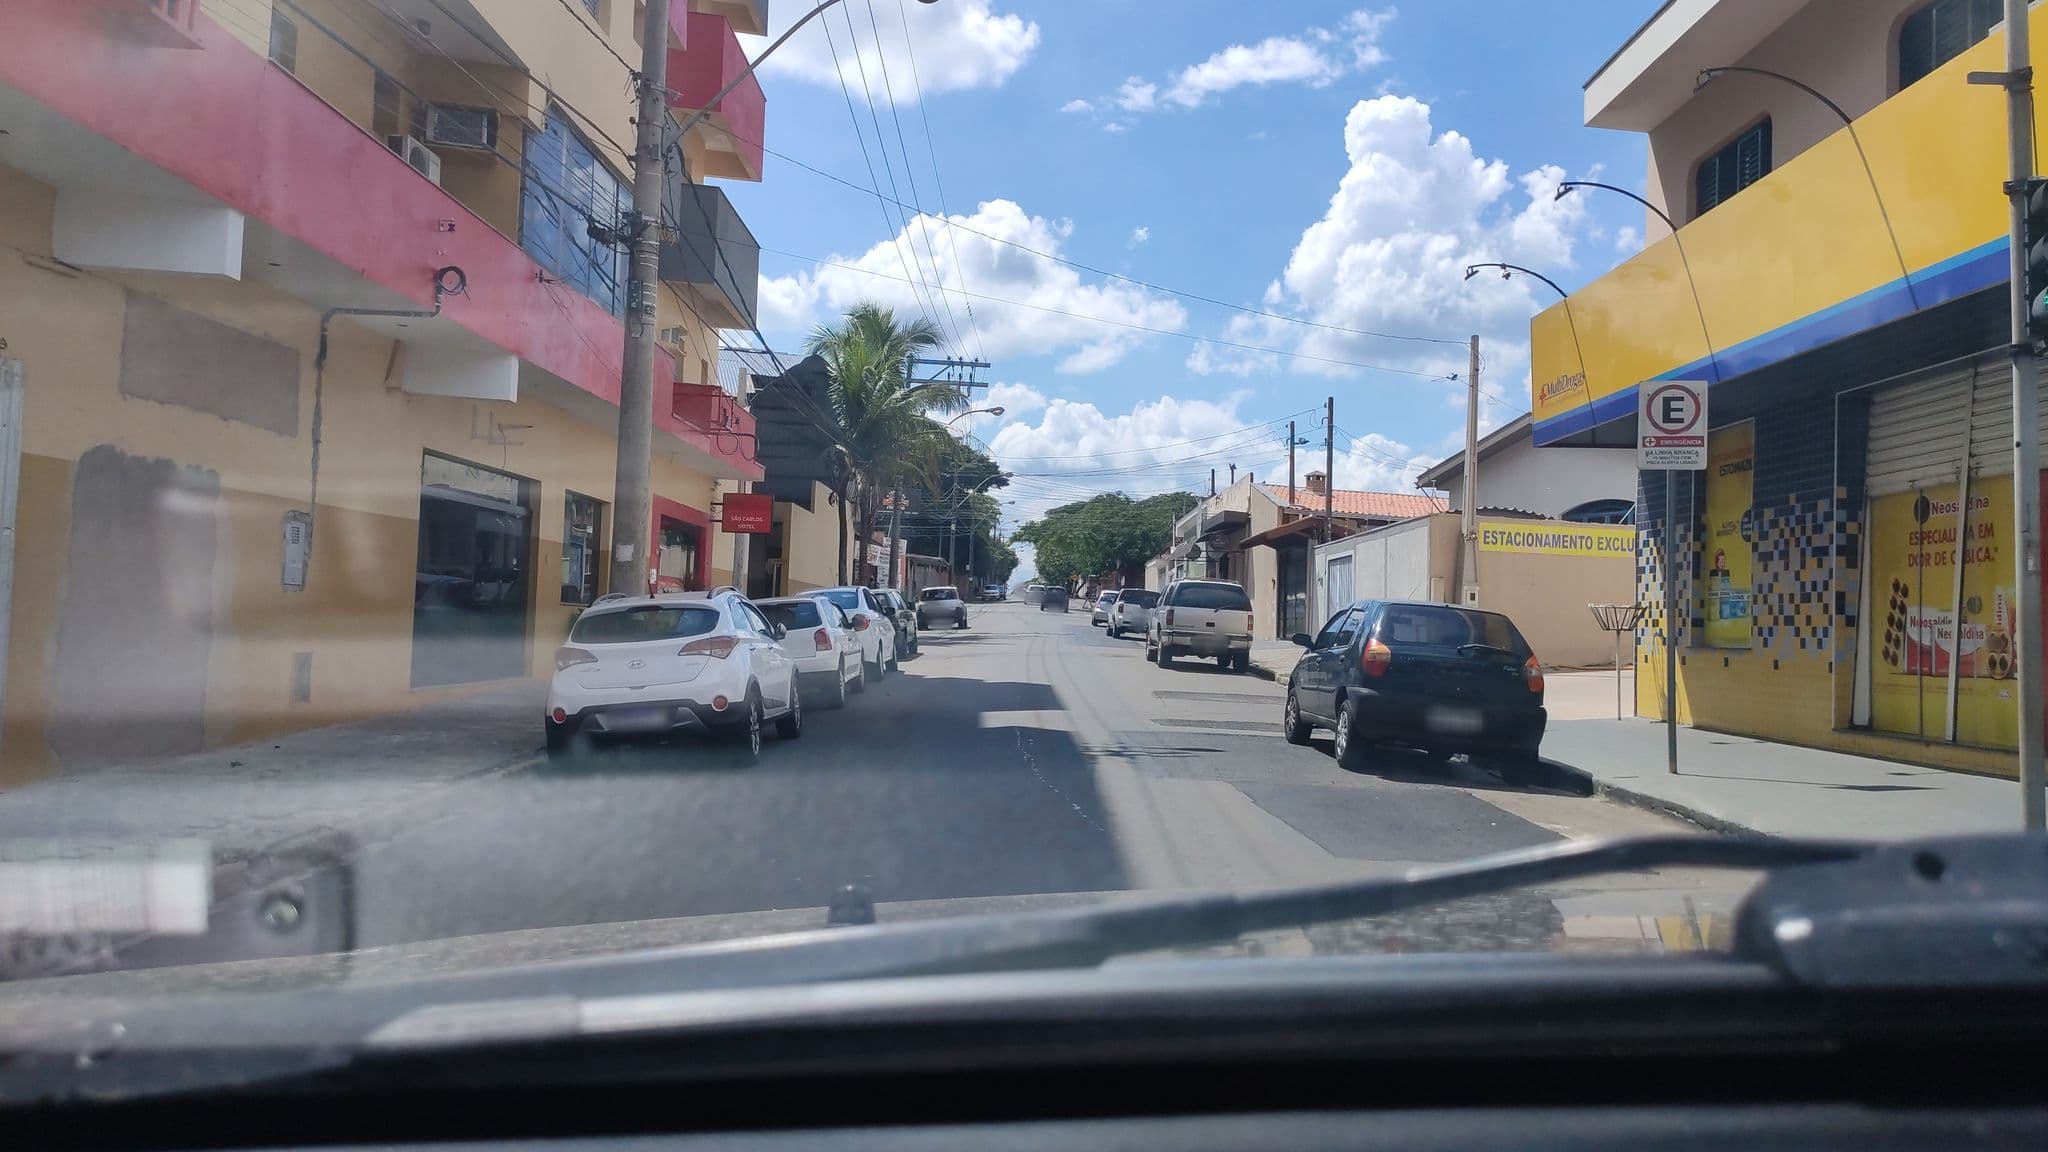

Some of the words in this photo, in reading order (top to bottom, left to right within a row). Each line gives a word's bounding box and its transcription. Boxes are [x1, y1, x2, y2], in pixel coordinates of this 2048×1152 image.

[1662, 396, 1684, 423] E
[1978, 521, 1994, 539] EM
[1483, 530, 1593, 550] ESTACIONAMENTO
[1597, 537, 1635, 552] EXCLU
[1934, 551, 1946, 566] DE
